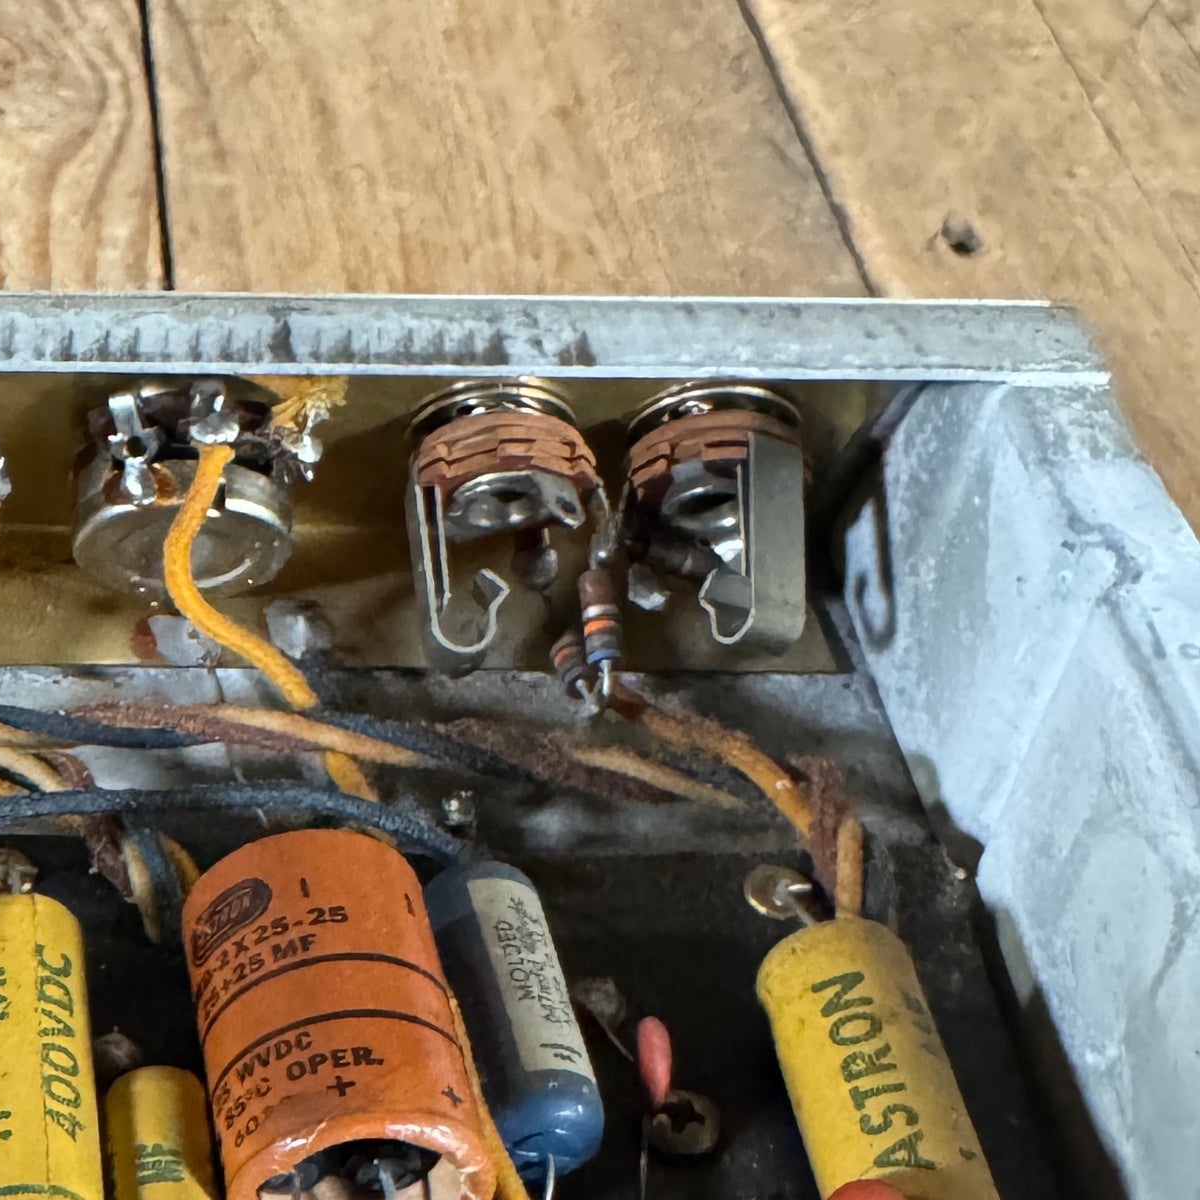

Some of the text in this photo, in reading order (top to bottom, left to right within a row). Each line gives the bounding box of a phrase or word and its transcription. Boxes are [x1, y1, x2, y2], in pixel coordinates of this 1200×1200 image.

[272, 933, 317, 963] MF
[35, 943, 85, 1143] 400VDC
[236, 1031, 313, 1086] WVDC
[811, 971, 937, 1170] ASTRON
